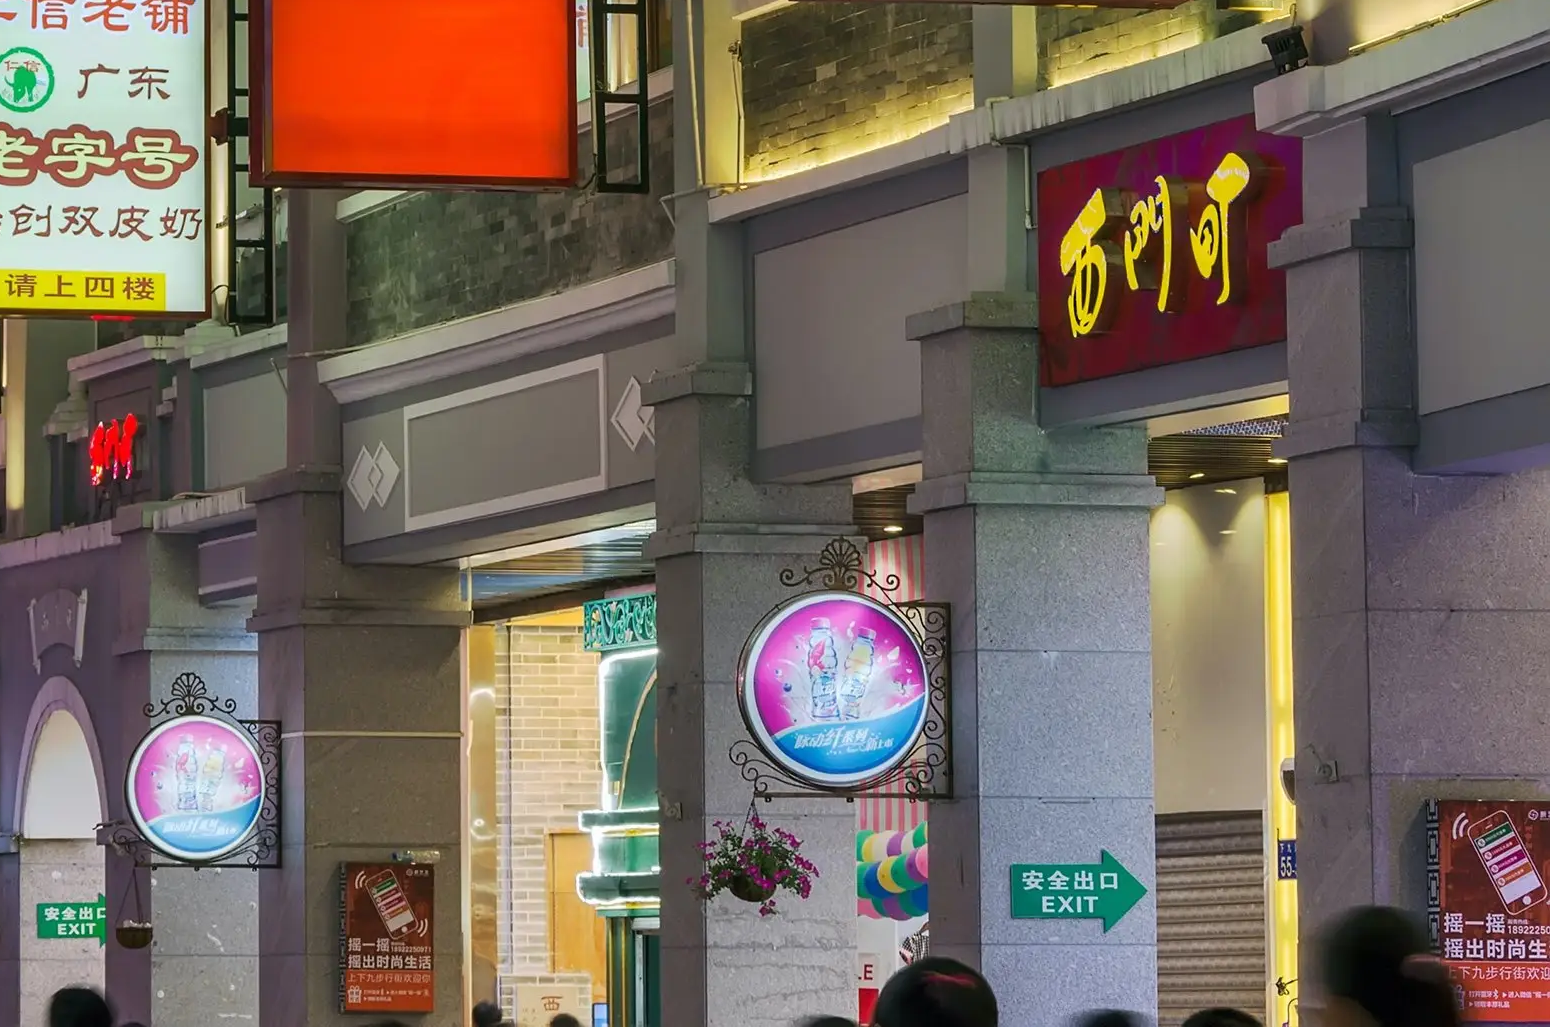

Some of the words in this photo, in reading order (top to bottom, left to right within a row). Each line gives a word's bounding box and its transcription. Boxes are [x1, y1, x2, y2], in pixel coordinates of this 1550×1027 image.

[77, 63, 171, 100] 广东
[4, 273, 156, 302] 请上四楼
[1280, 856, 1298, 878] 55-
[1022, 870, 1119, 892] 安全出口
[44, 906, 106, 922] 安全出口
[1041, 896, 1099, 914] EXIT
[56, 923, 97, 936] EXIT
[1443, 913, 1506, 934] 摇一摇
[348, 937, 390, 953] 摇一摇
[1444, 938, 1550, 960] 摇出时尚生
[348, 955, 432, 970] 摇出时尚生活
